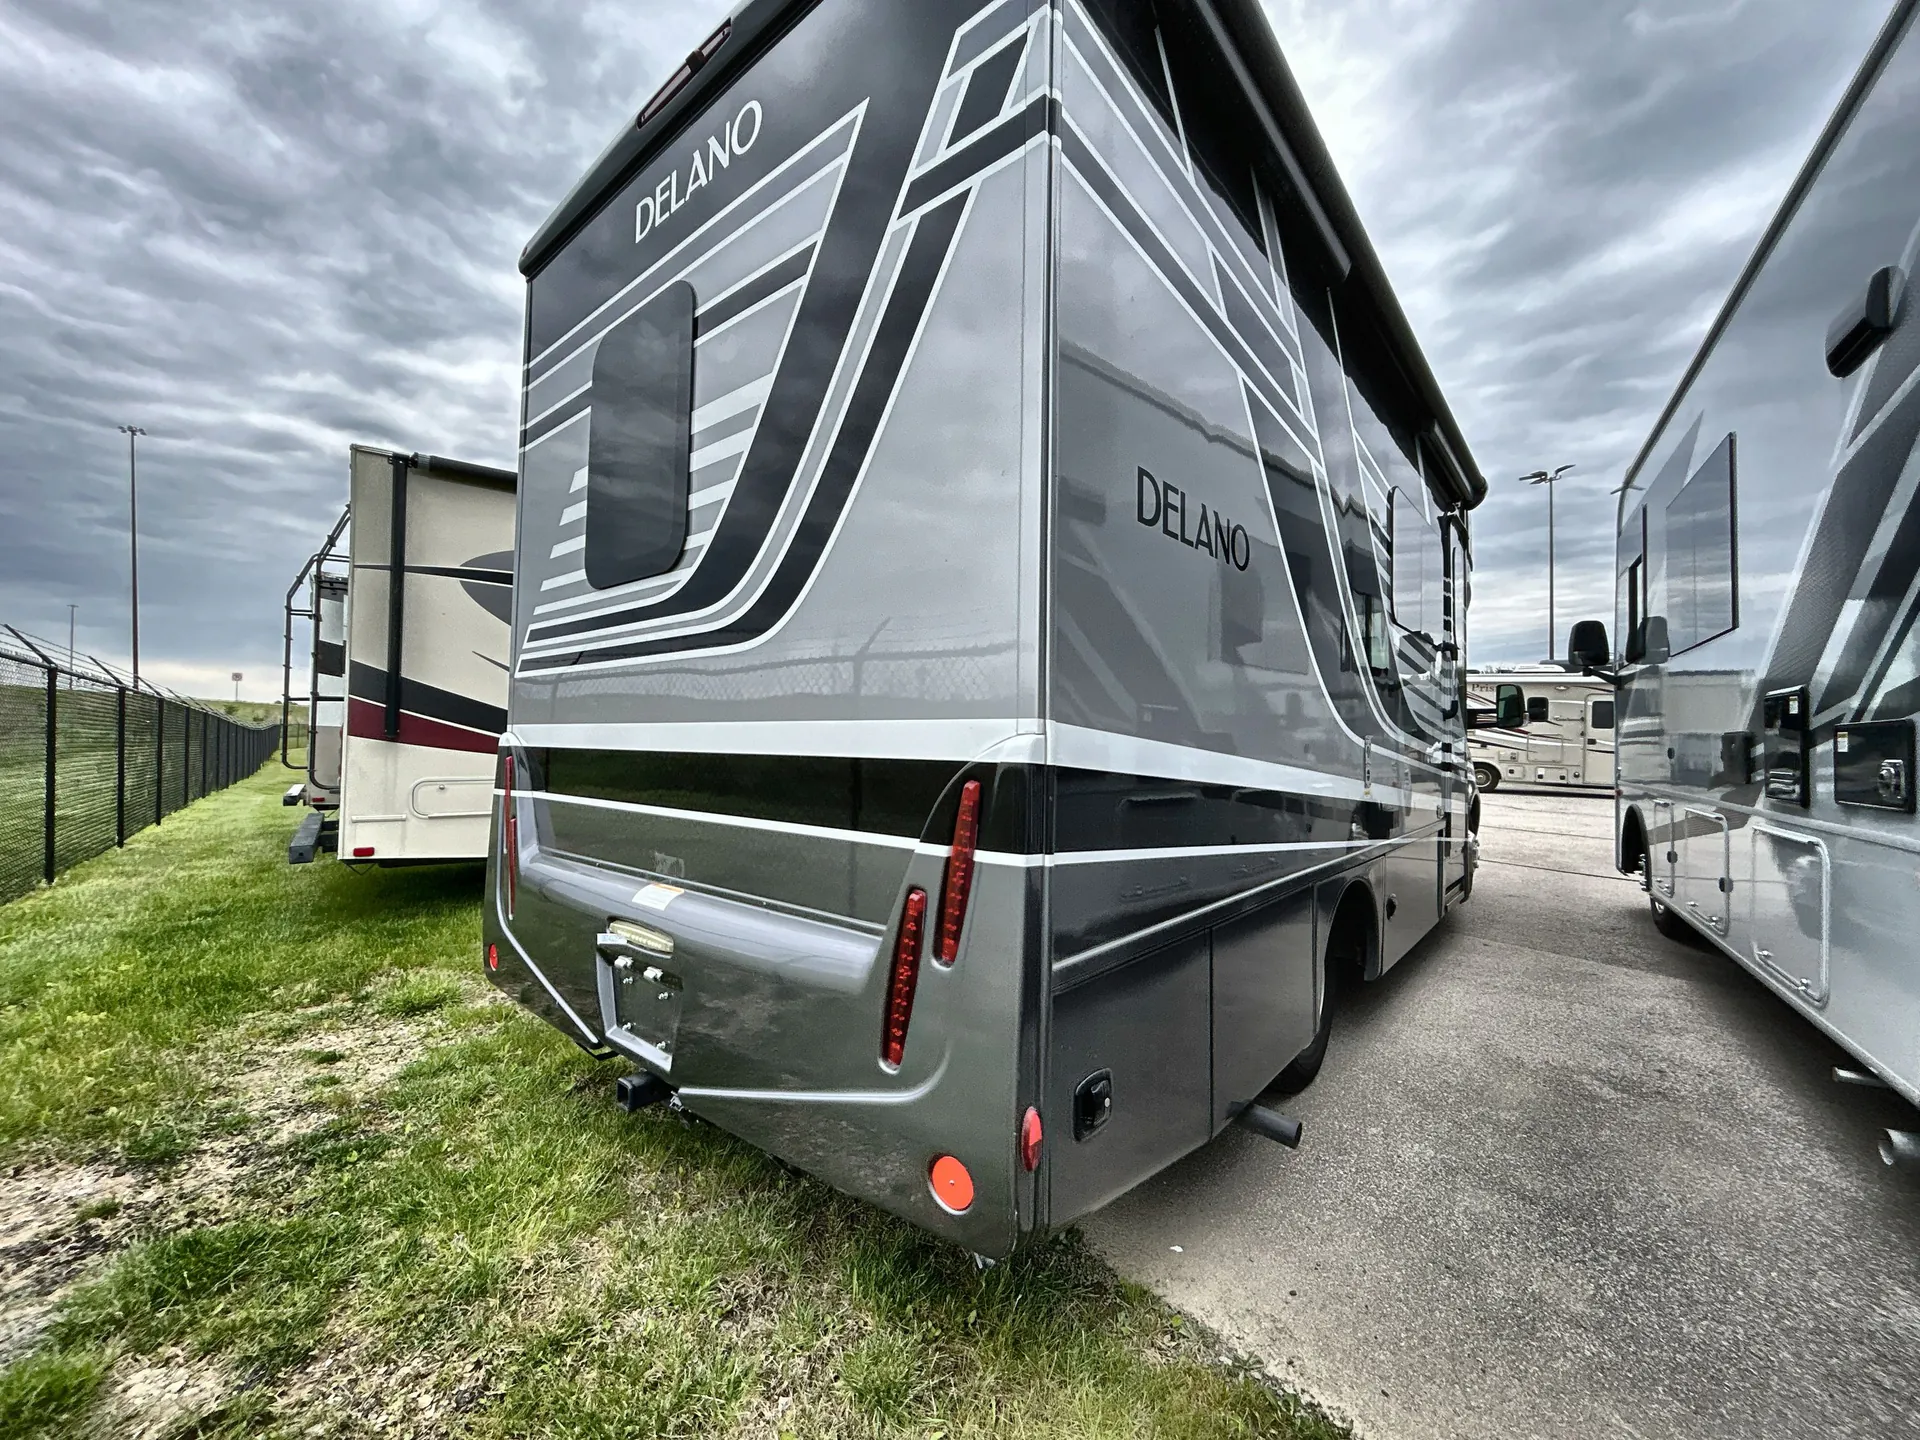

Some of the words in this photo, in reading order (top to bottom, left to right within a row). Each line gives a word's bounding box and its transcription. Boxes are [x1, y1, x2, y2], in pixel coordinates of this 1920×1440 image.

[635, 100, 763, 244] DELANO
[1137, 465, 1250, 572] DELANO
[1471, 683, 1495, 692] Pris
